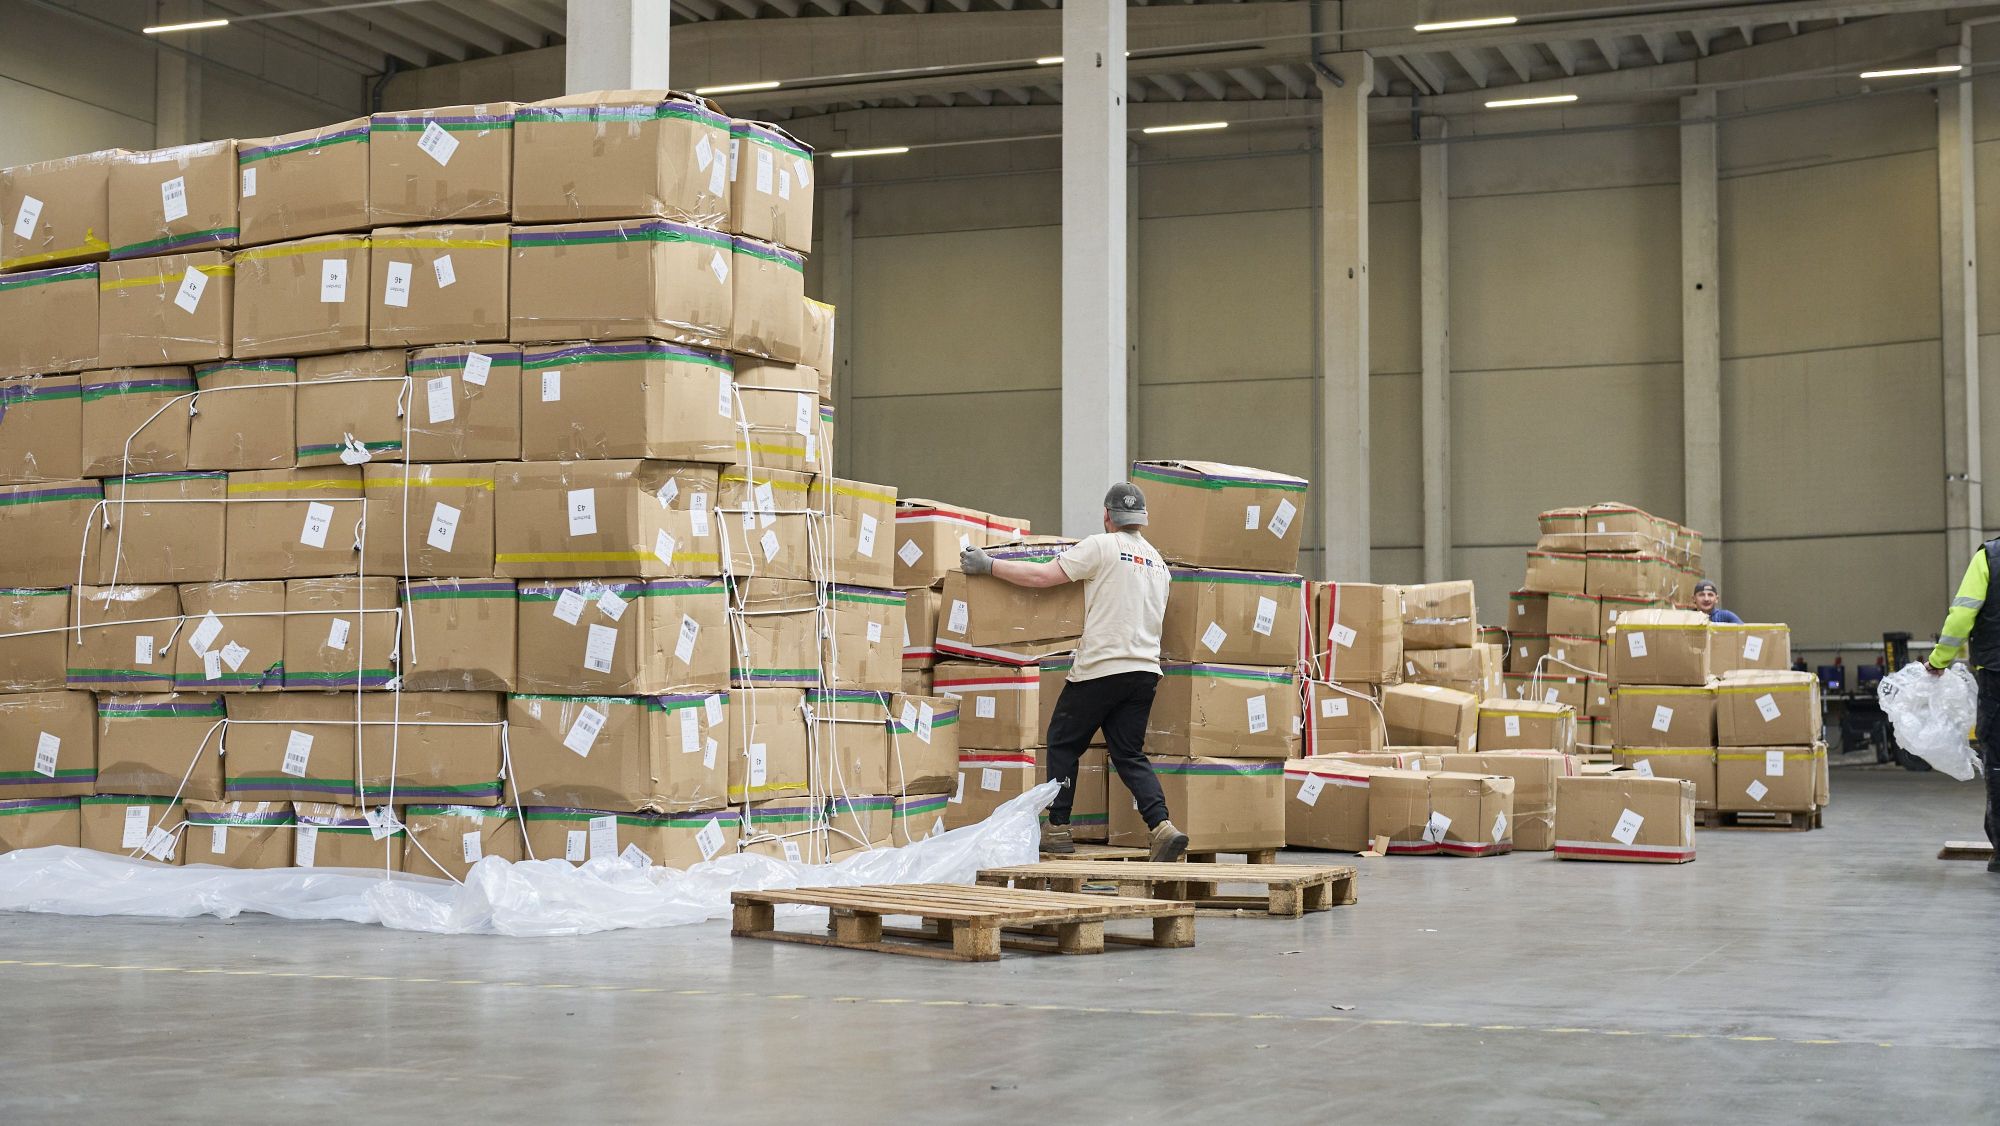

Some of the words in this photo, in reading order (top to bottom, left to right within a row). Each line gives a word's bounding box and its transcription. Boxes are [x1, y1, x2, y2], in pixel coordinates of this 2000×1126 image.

[330, 273, 338, 281] 46
[189, 282, 198, 291] 43
[577, 504, 586, 512] 43
[311, 525, 320, 533] 43
[438, 527, 447, 535] 43
